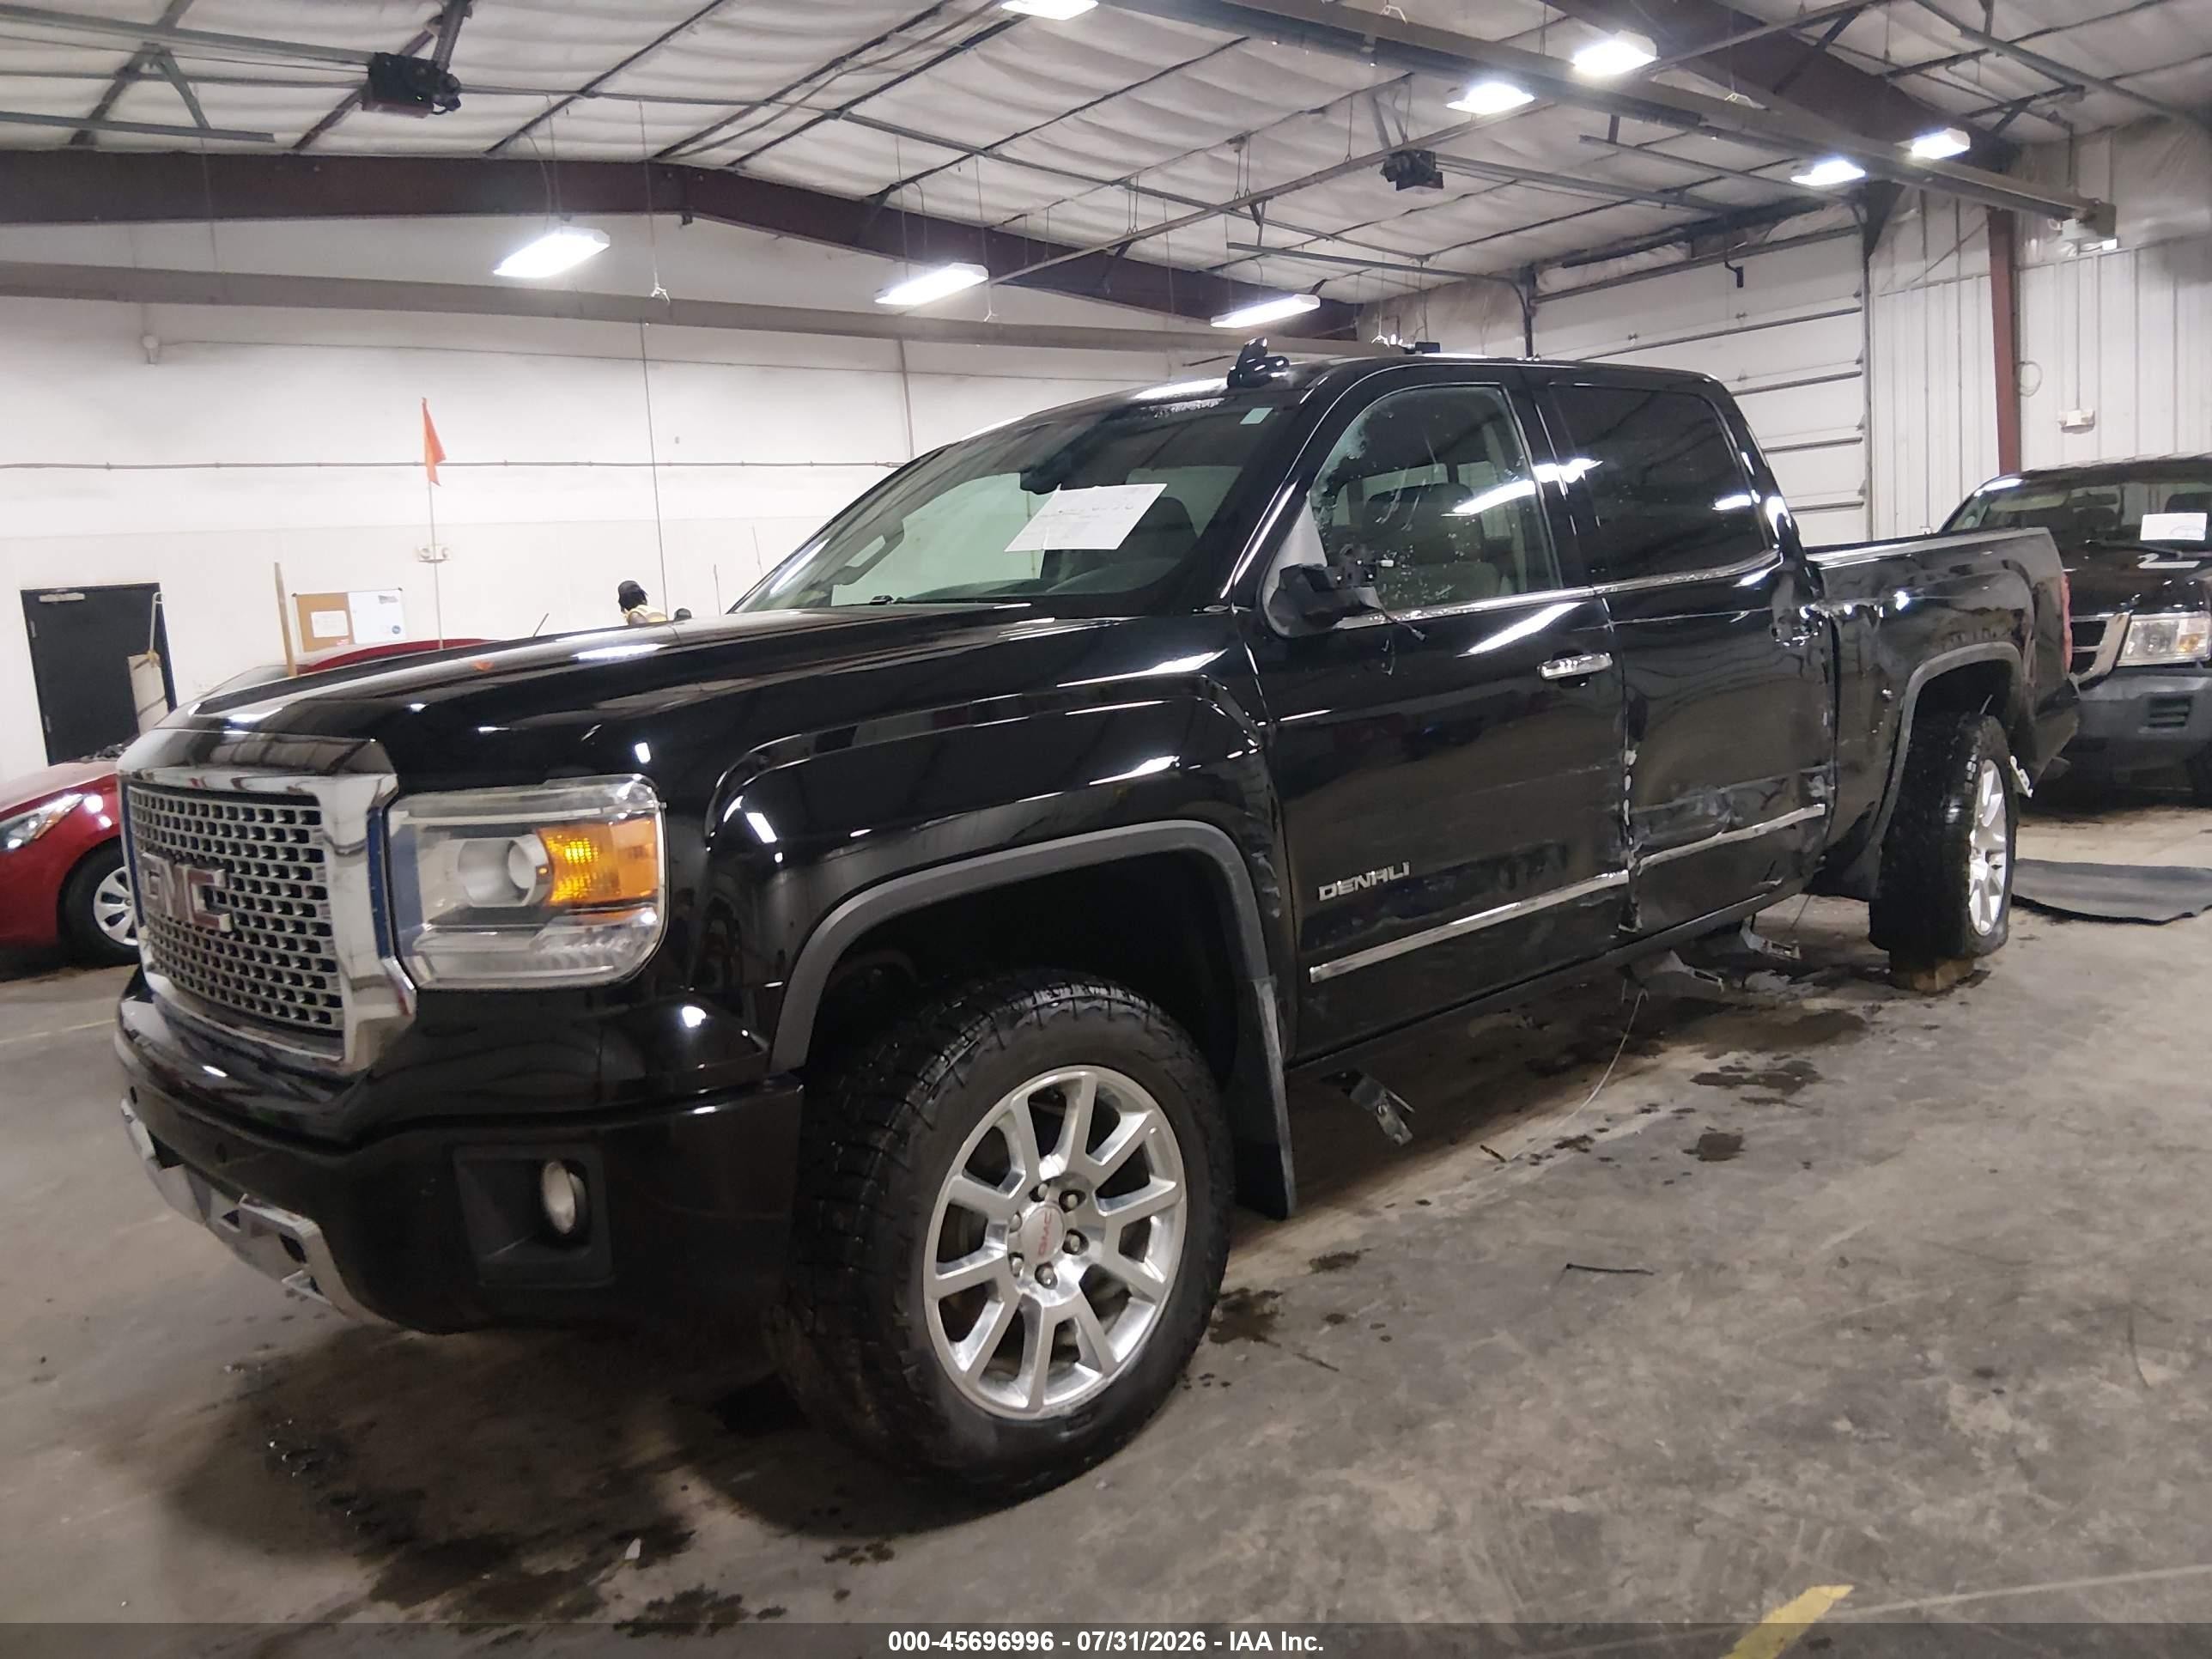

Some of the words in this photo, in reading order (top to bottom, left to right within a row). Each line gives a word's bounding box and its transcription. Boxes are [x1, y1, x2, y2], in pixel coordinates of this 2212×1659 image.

[141, 852, 232, 933] GMC
[1318, 861, 1410, 901] DENALI
[1038, 1210, 1052, 1256] GMC
